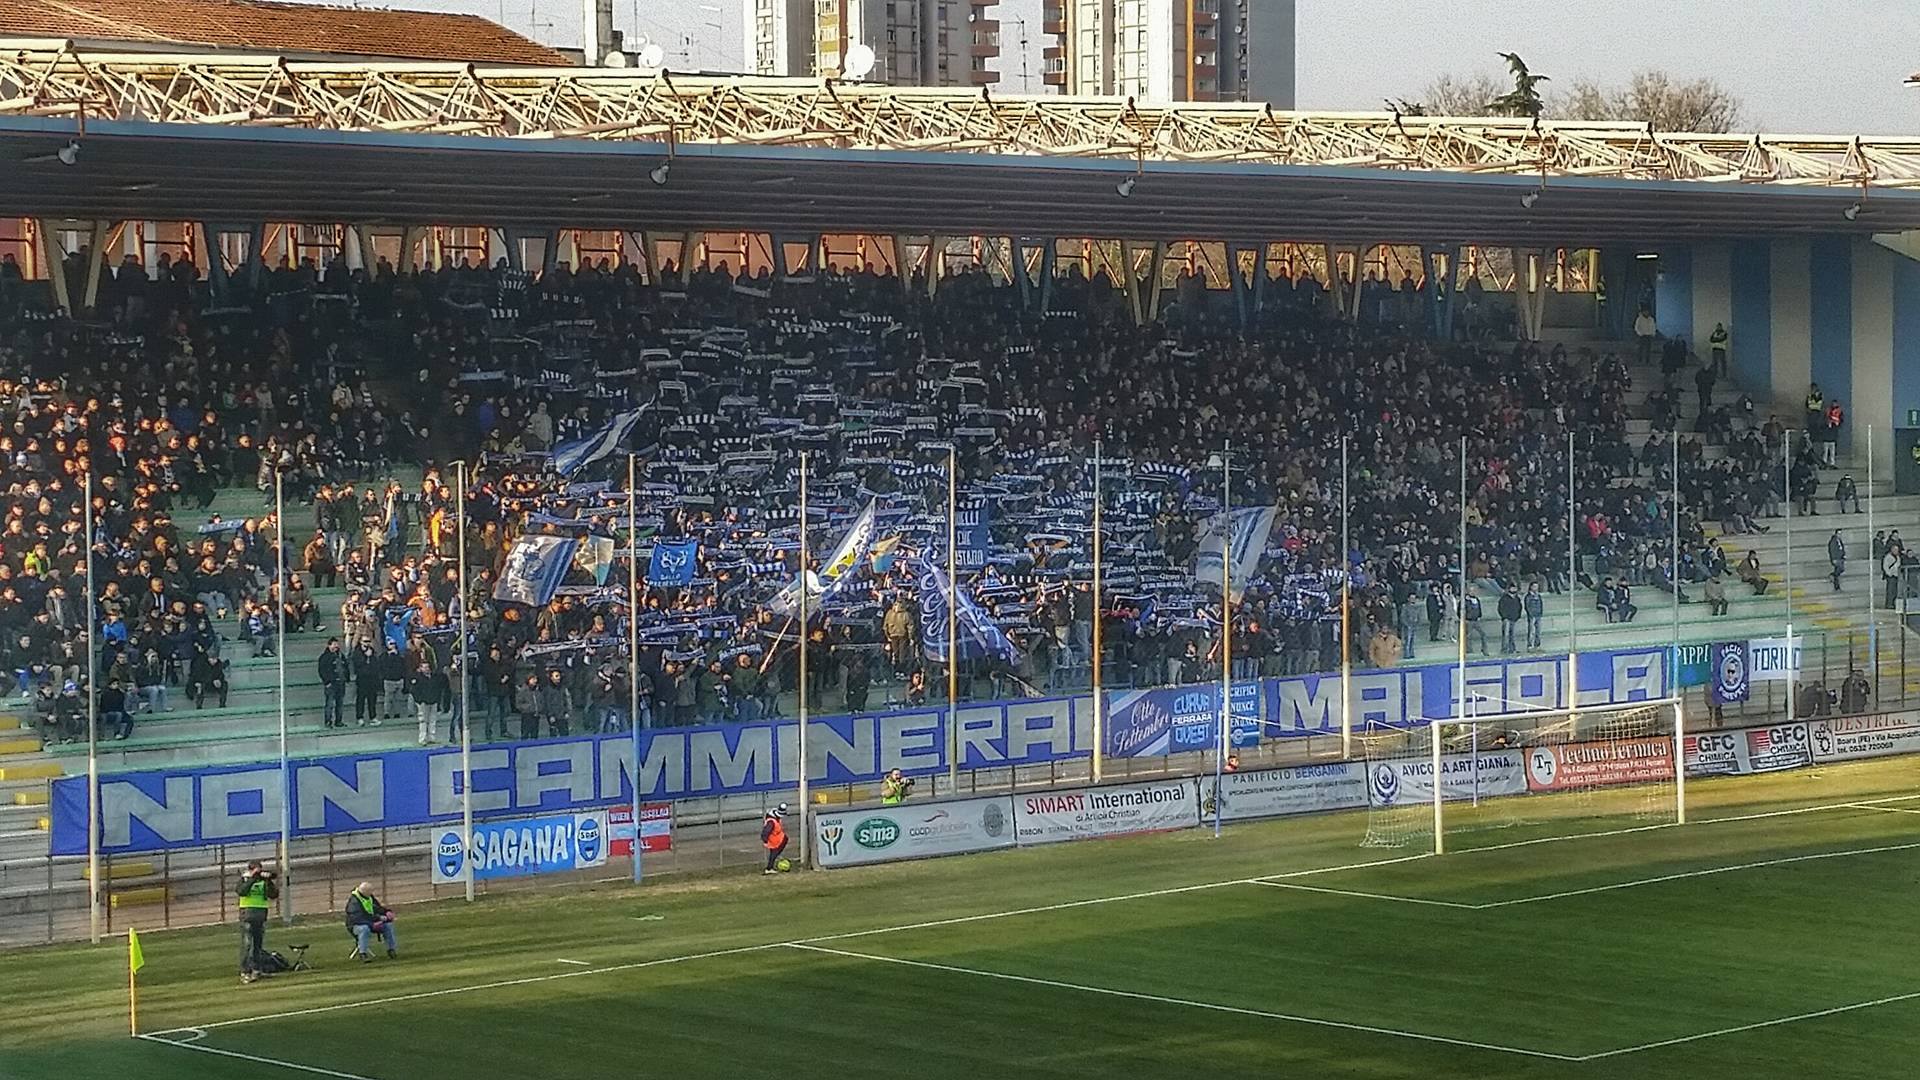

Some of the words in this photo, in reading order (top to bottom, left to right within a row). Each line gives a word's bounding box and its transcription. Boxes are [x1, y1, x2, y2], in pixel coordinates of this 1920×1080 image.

[1751, 646, 1801, 672] TORIO
[1219, 685, 1256, 698] SCRIFICI
[1174, 692, 1211, 714] CURVA
[1171, 713, 1212, 725] FERRARA
[1835, 713, 1890, 731] DESTRI
[1175, 724, 1210, 744] OVEST
[1697, 734, 1735, 752] GFC
[1769, 725, 1806, 745] GFC
[101, 758, 385, 847] NON
[428, 696, 1096, 817] CAMMINERAI
[1278, 671, 1423, 731] MAI
[1450, 651, 1663, 717] SOLA
[1558, 740, 1667, 765] TechnoTermica
[1699, 751, 1737, 763] CHIMICA
[1770, 742, 1807, 755] CHIMICA
[1232, 770, 1291, 784] PANIFICIO
[1294, 764, 1349, 780] BERGAMINI
[1402, 761, 1450, 777] AVICOA
[1452, 756, 1510, 773] ARTGIANA
[1026, 795, 1085, 815] SIMART
[1089, 784, 1185, 810] International
[472, 822, 572, 870] SAGANA'
